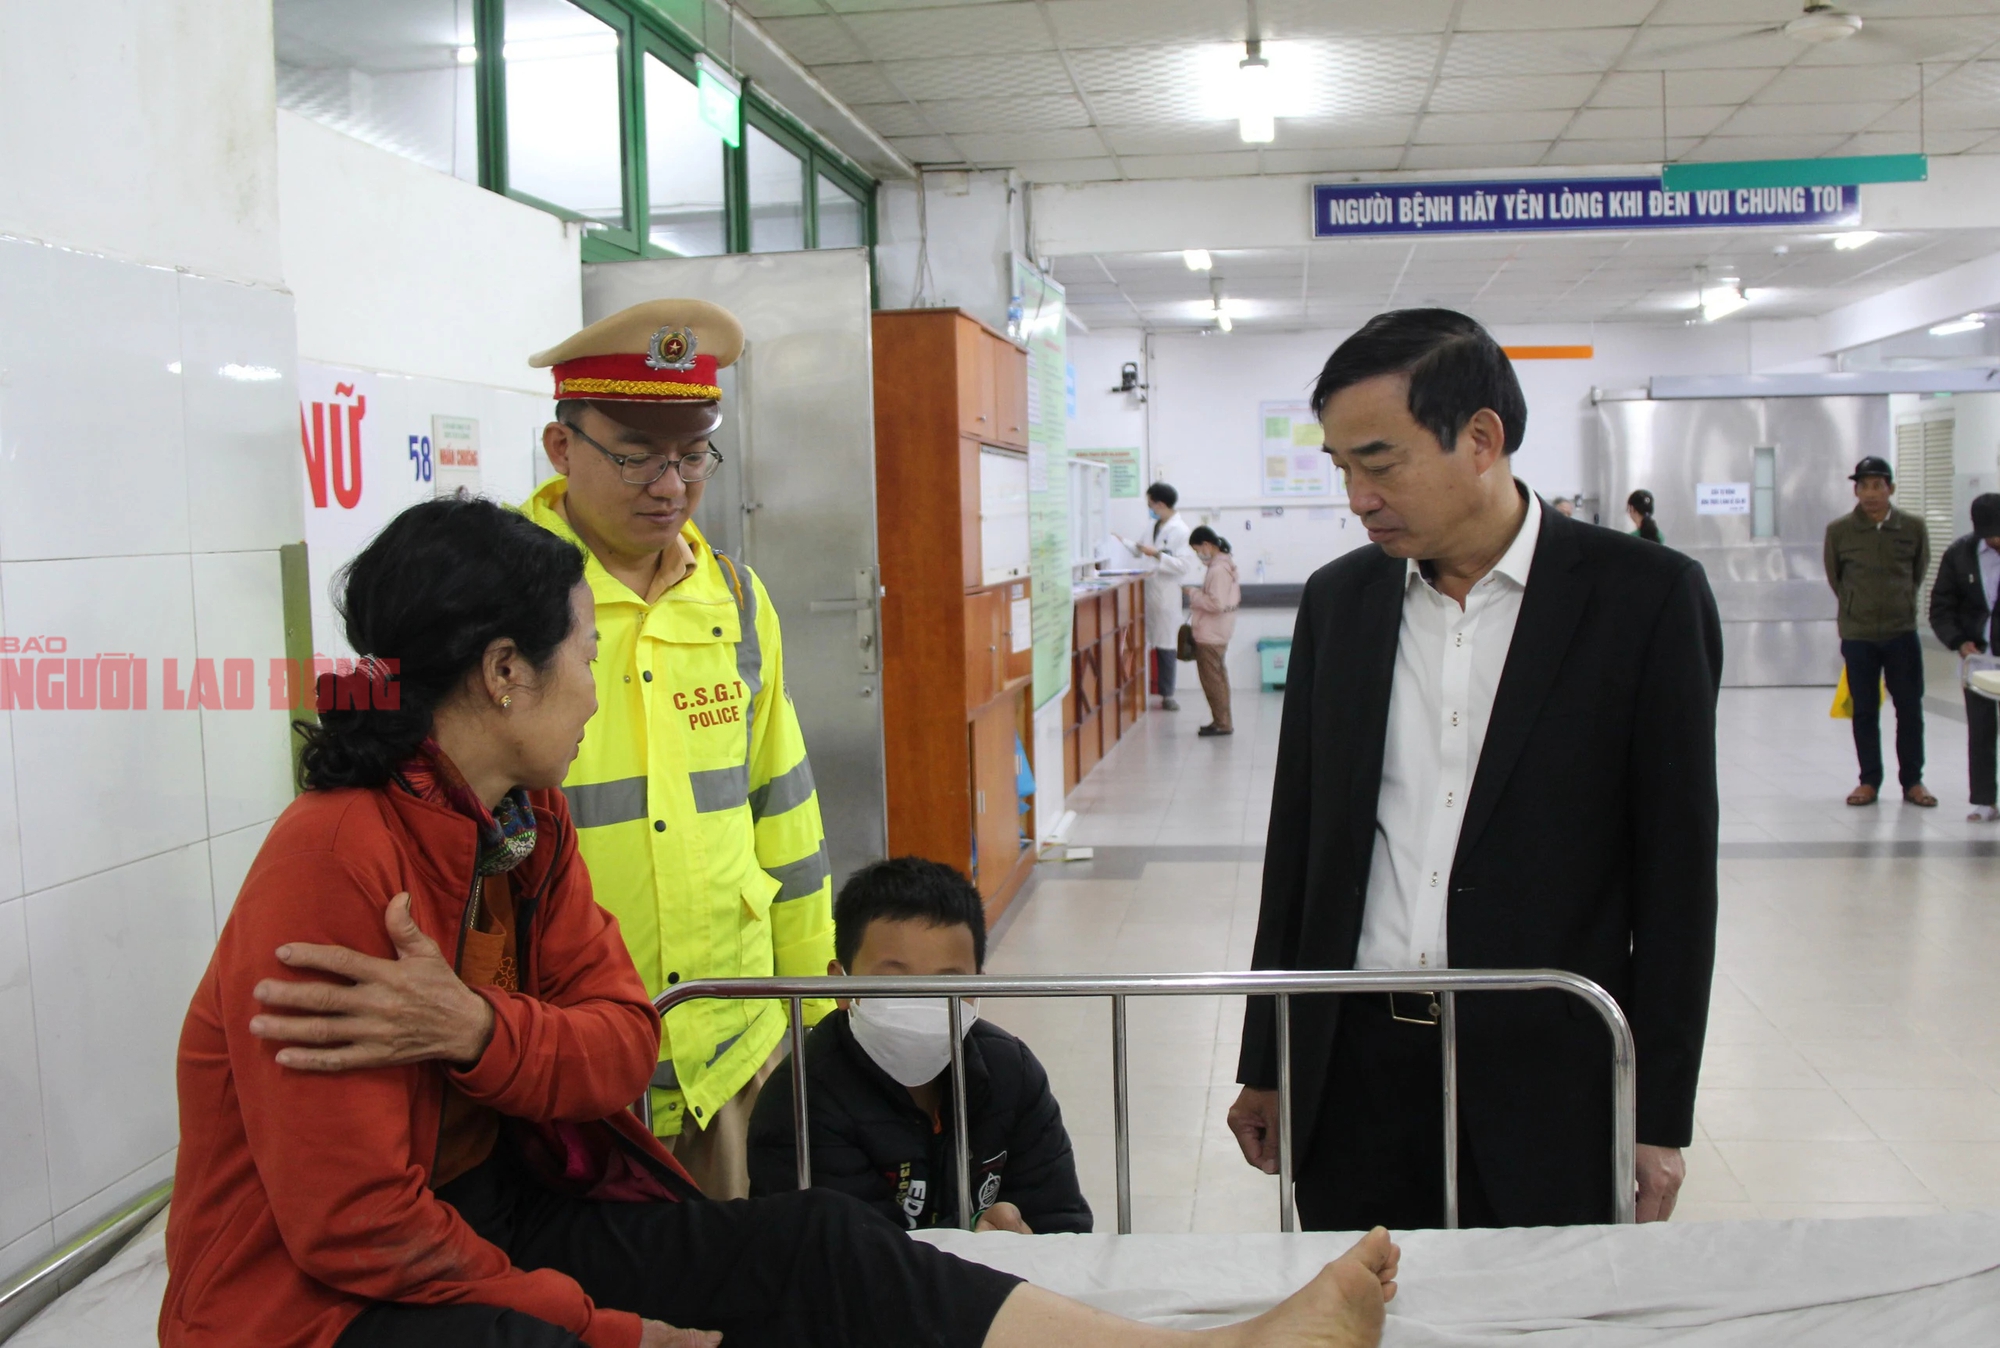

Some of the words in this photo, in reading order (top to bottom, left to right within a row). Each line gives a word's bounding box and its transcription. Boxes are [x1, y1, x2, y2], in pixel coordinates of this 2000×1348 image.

[1330, 192, 1393, 225] NGƯỜI
[1399, 191, 1453, 228] BỆNH
[1459, 190, 1498, 221] HÃY
[1503, 189, 1544, 220] YÊN
[1550, 187, 1604, 219] LÒNG
[1609, 190, 1643, 217] KHI
[300, 381, 366, 509] NỮ
[408, 435, 431, 482] 58
[1245, 520, 1252, 531] 6
[1340, 518, 1347, 529] 7
[673, 681, 743, 710] C.S.G.T
[688, 706, 740, 730] POLICE
